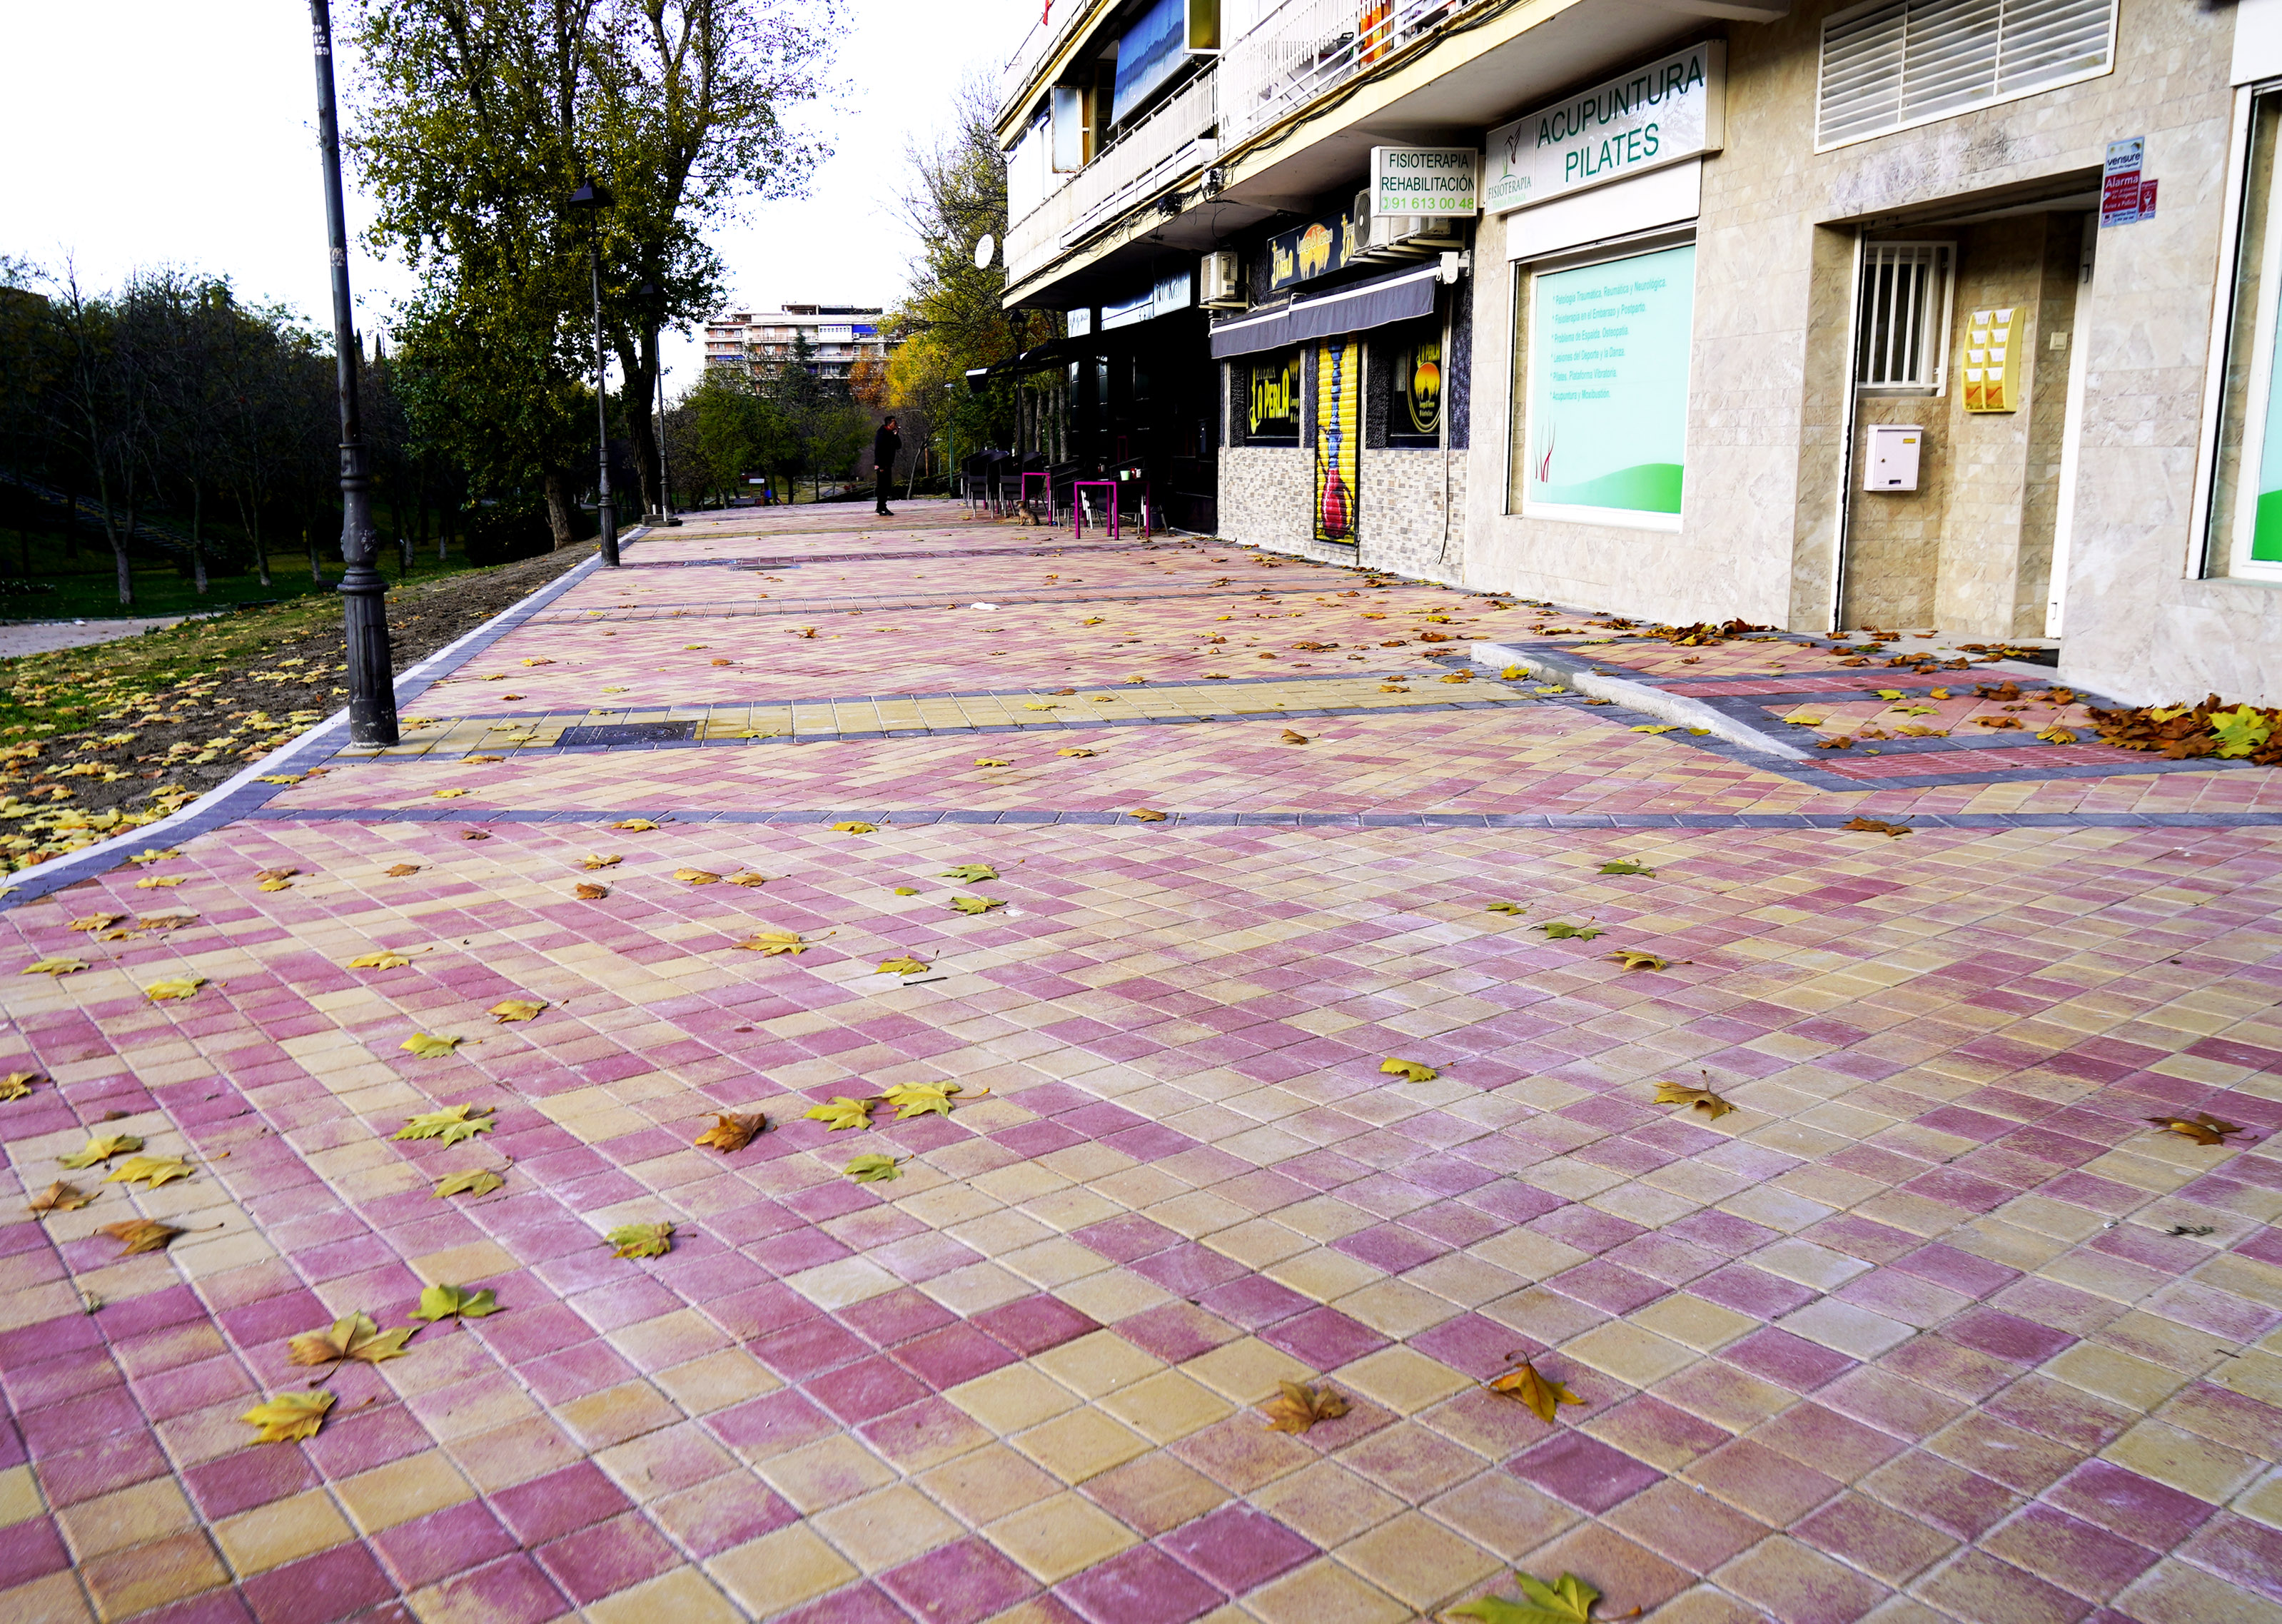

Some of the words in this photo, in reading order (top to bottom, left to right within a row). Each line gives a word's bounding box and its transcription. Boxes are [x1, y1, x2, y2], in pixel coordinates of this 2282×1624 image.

[314, 34, 326, 45] 12
[1537, 56, 1704, 148] ACUPUNTURA
[1389, 153, 1469, 168] FISIOTERAPIA
[1565, 123, 1659, 183] PILATES
[1381, 174, 1475, 191] REHABILITACIÓN
[1488, 176, 1532, 200] FISIOTERAPIA
[2105, 176, 2139, 188] Alarma
[1392, 198, 1406, 209] 91
[1411, 198, 1435, 210] 613
[1439, 198, 1455, 210] 00
[1458, 198, 1474, 210] 48
[1587, 309, 1592, 319] el
[1593, 308, 1615, 319] Embarazo
[1575, 332, 1581, 341] de
[1264, 368, 1289, 419] PERLA
